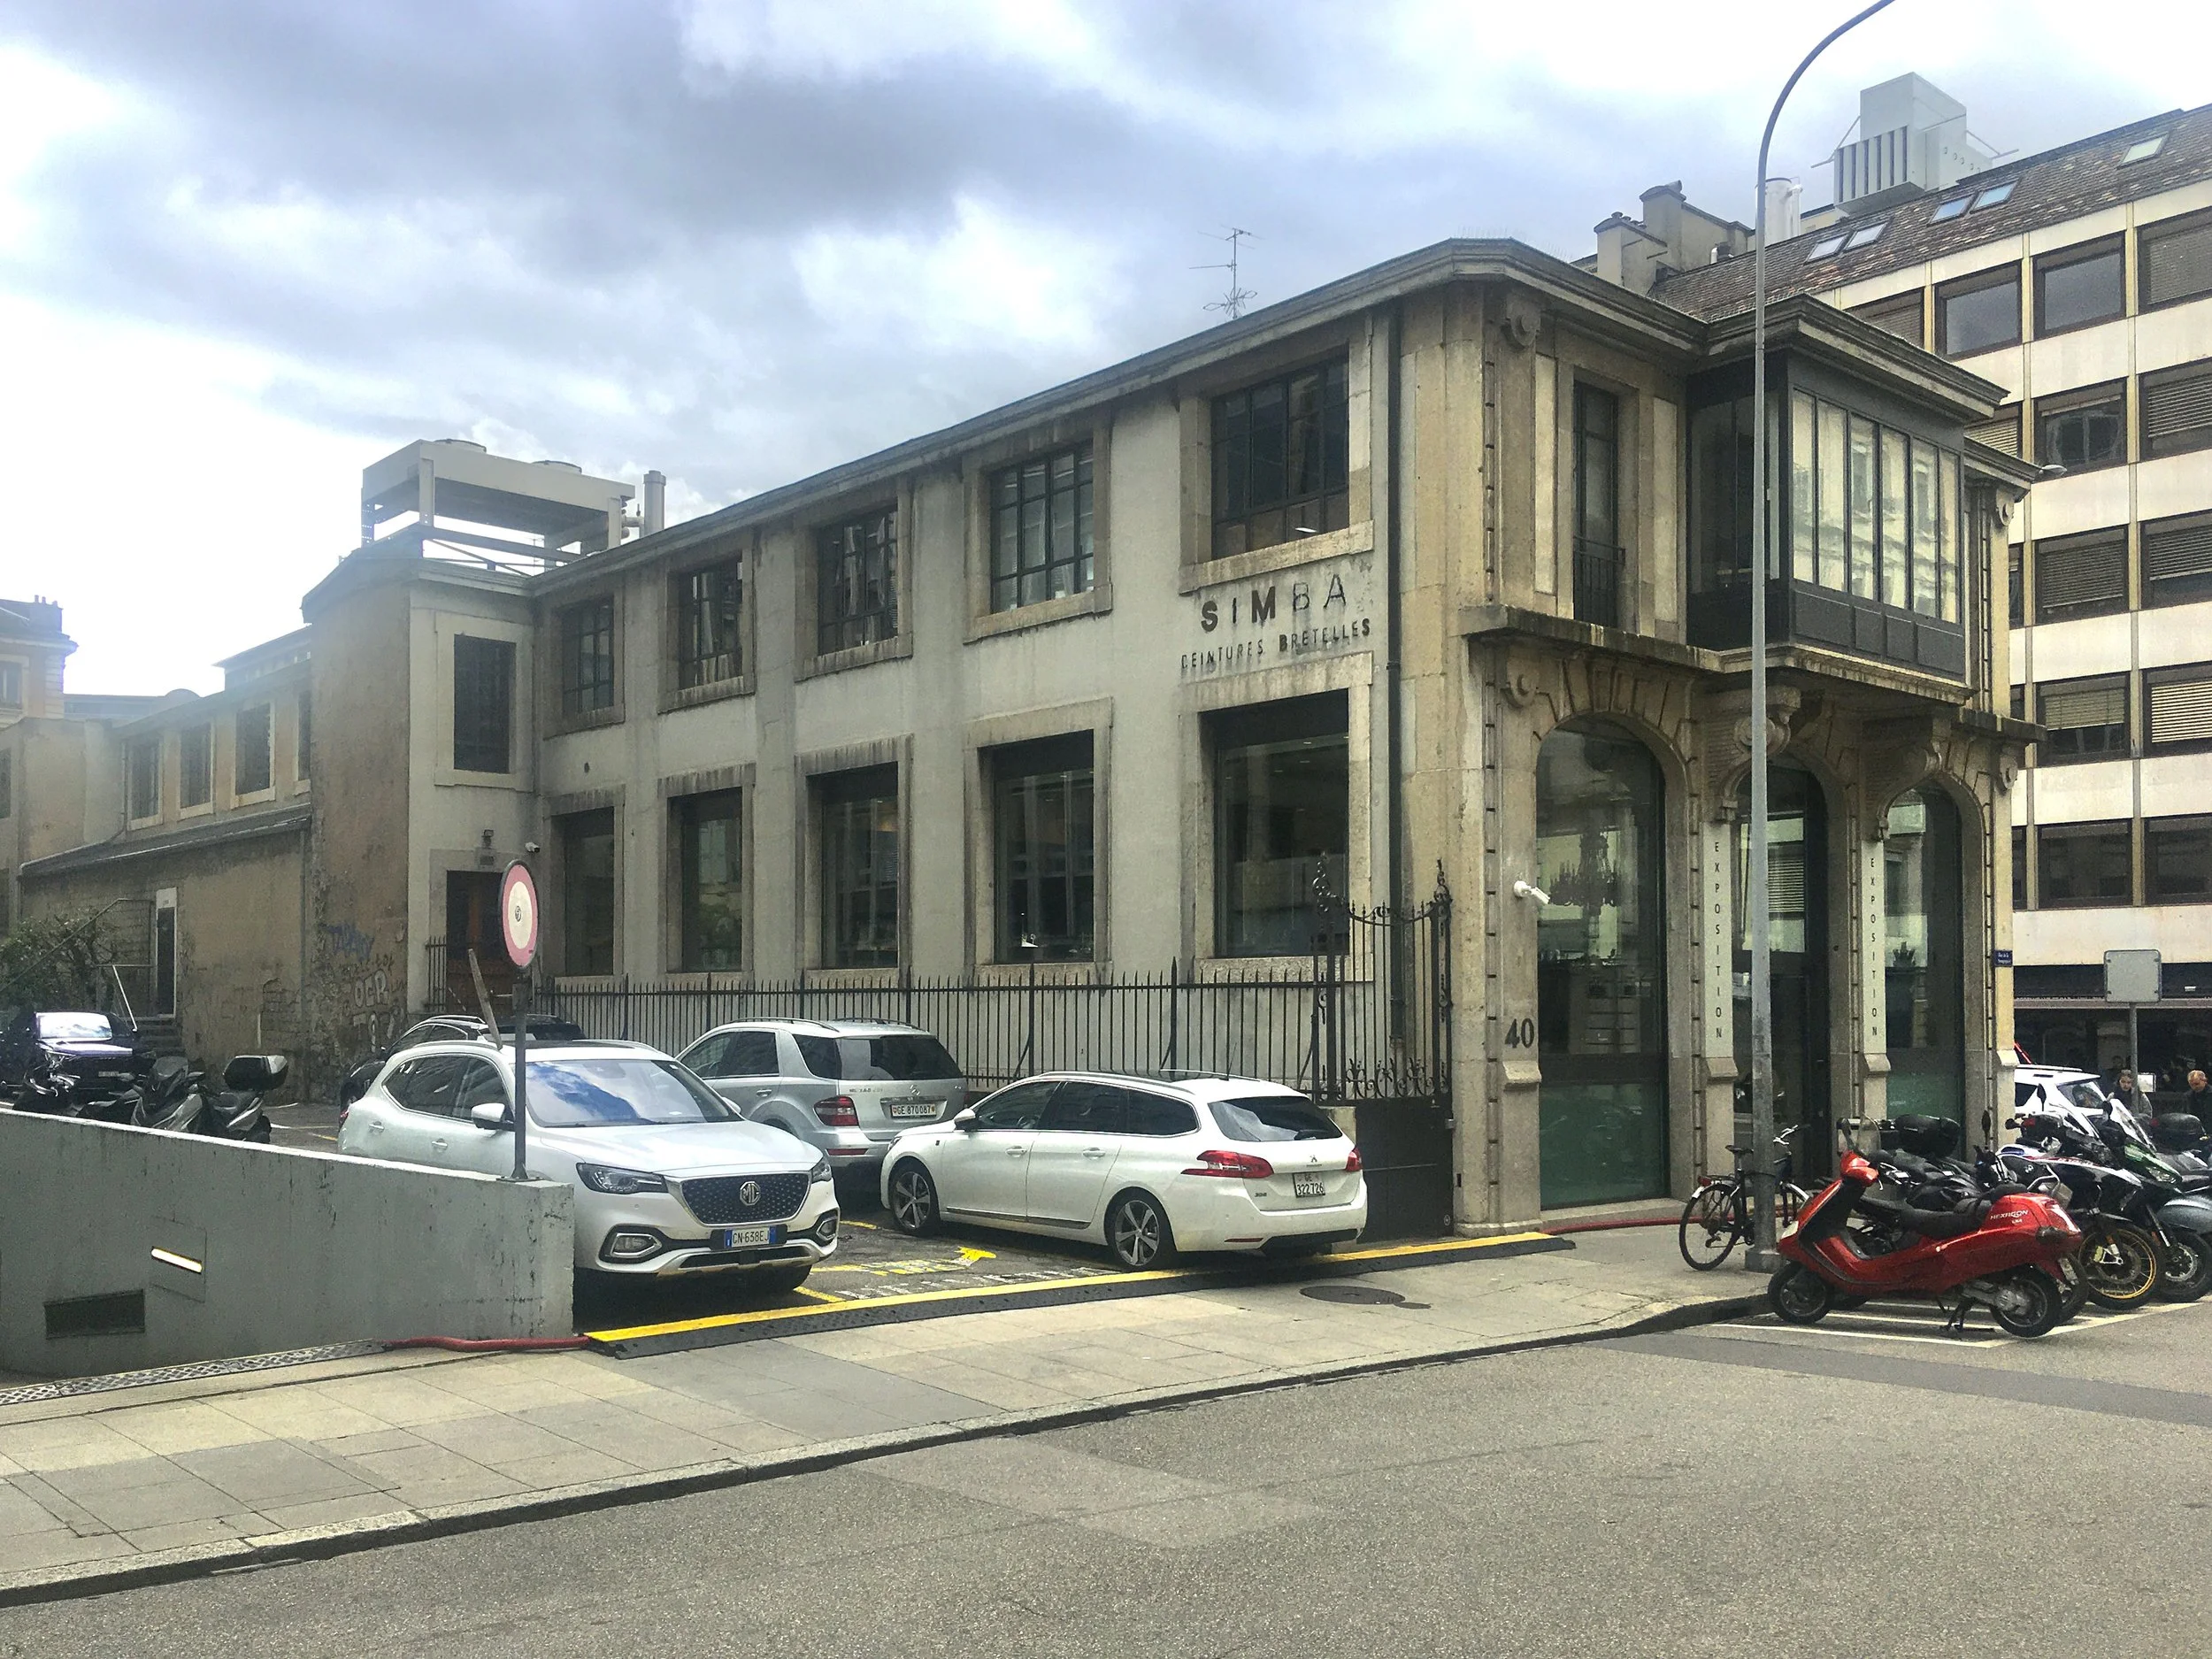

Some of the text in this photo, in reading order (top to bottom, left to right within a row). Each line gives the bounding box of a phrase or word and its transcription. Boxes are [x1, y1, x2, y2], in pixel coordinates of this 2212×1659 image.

[1200, 573, 1346, 634] SIMBA
[1180, 618, 1371, 670] CEINTURES BRETELLES
[1714, 841, 1723, 1039] EXPOSITION
[1504, 1018, 1535, 1049] 40
